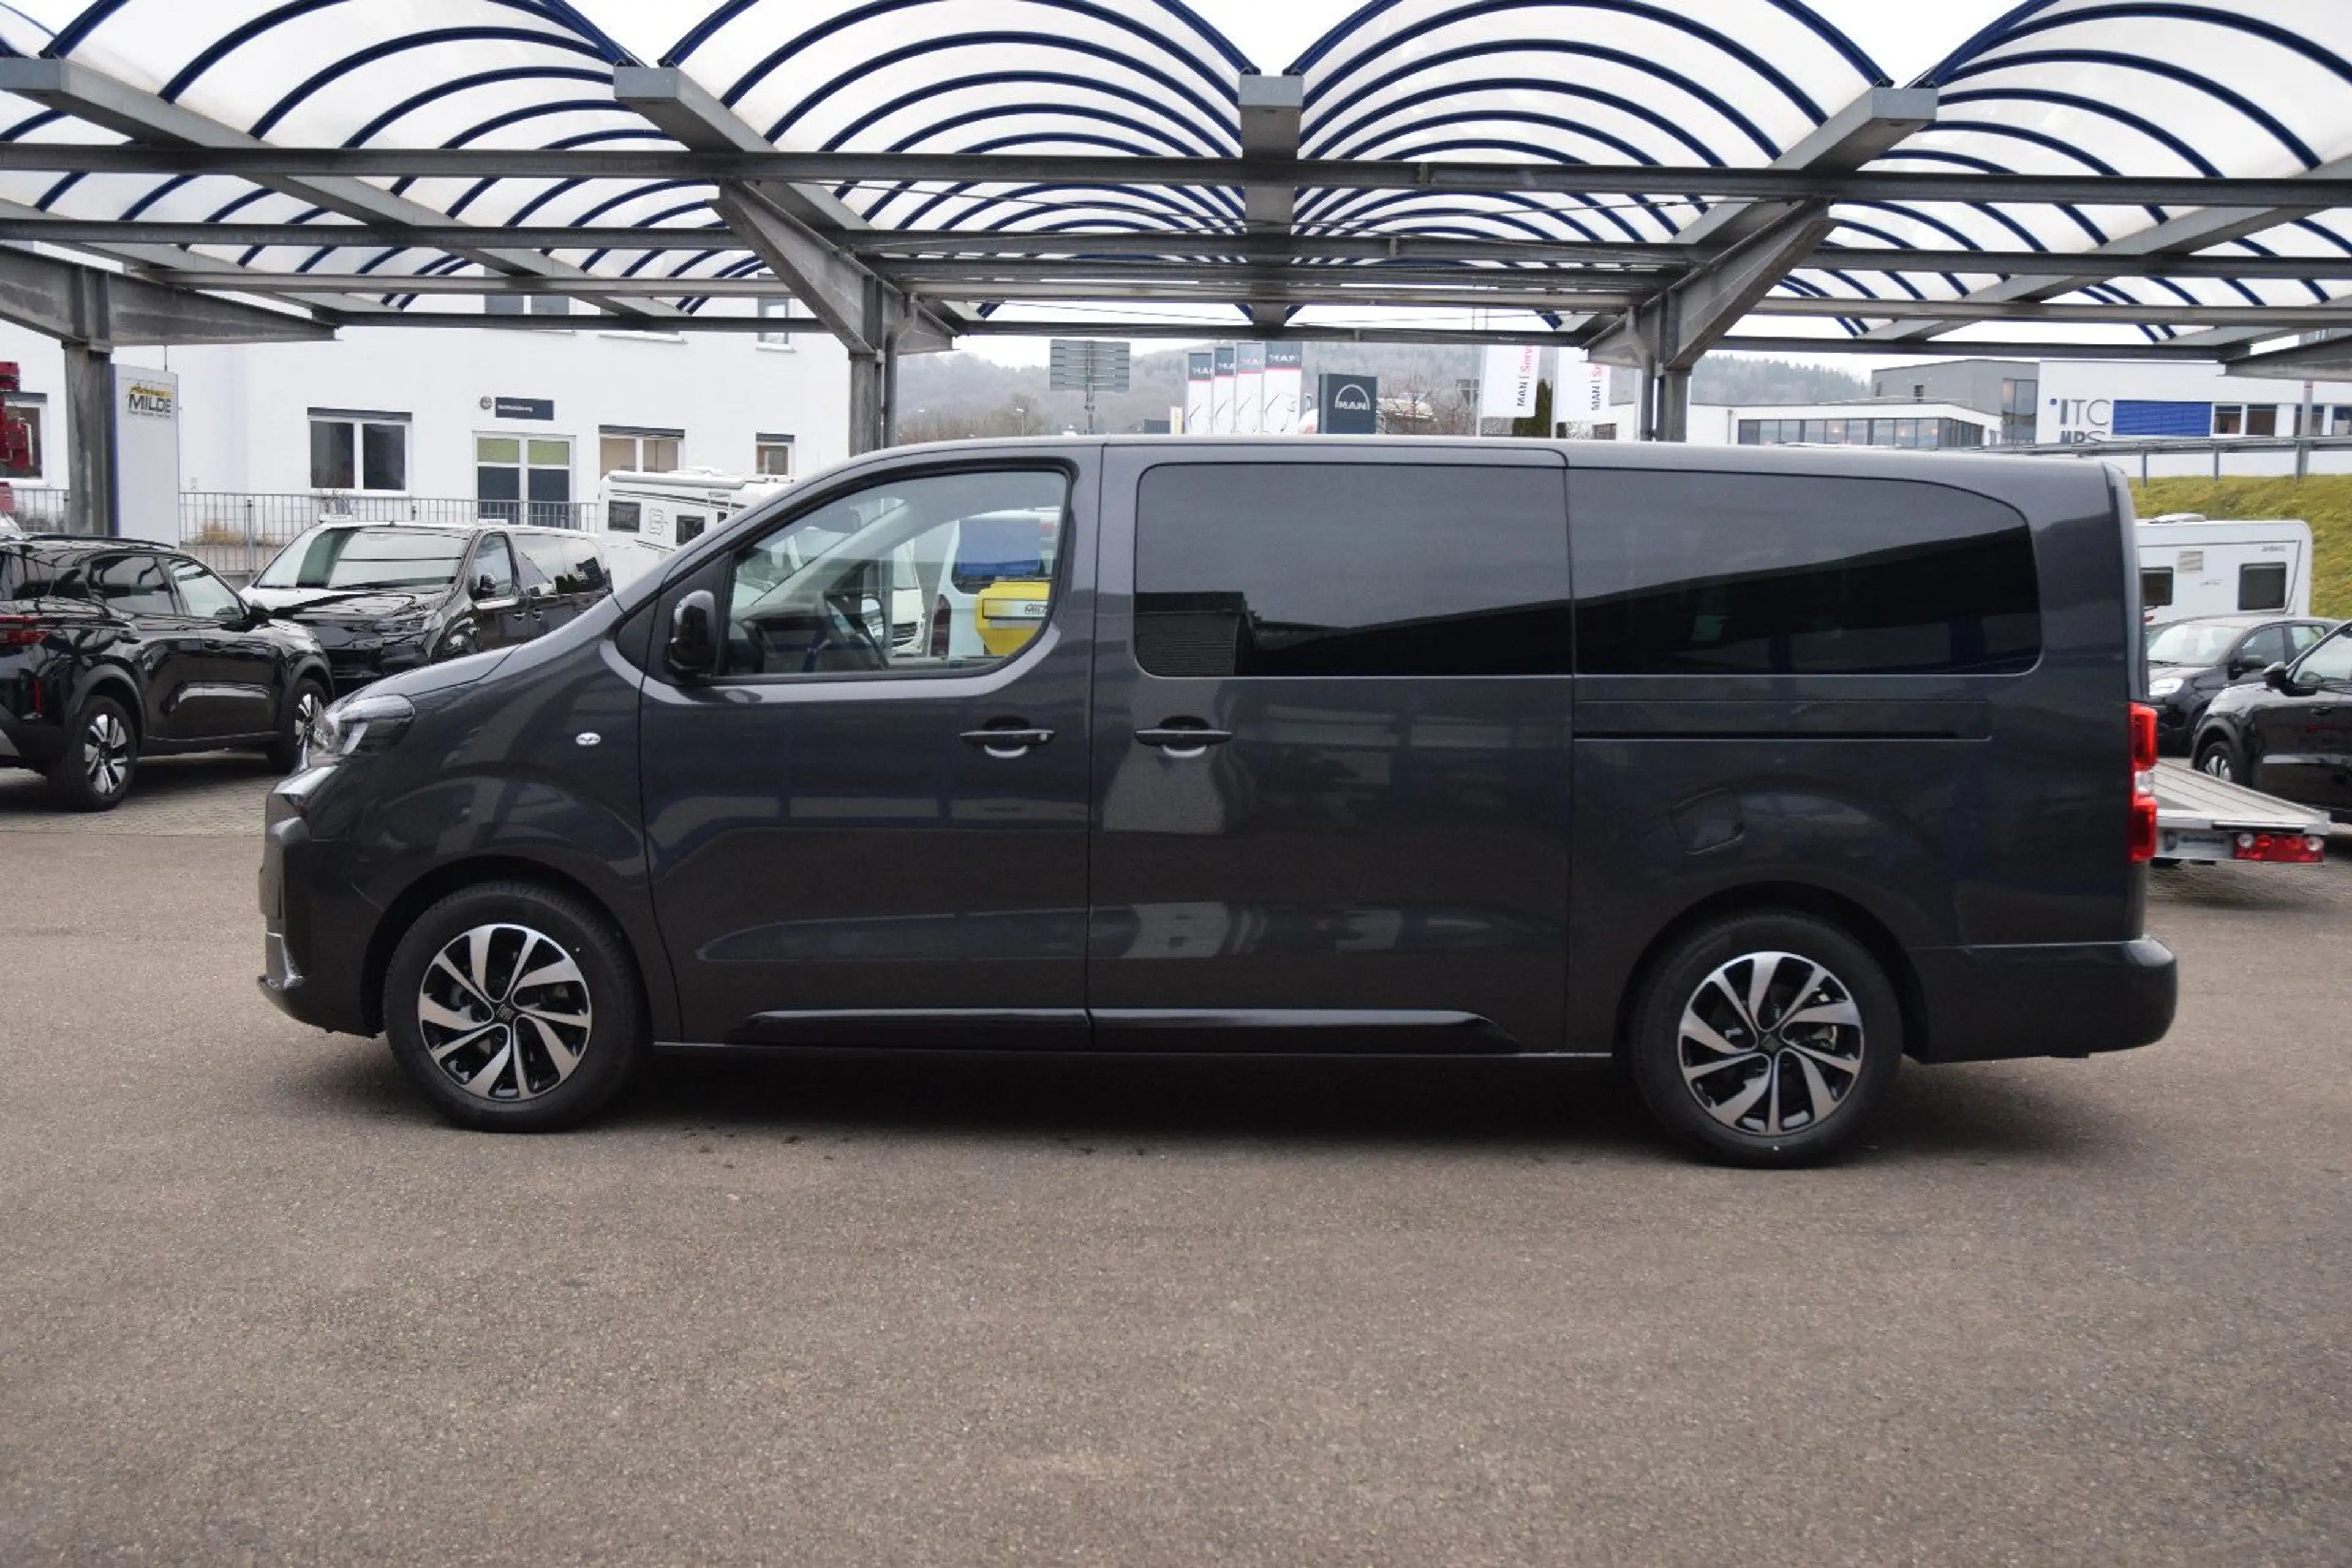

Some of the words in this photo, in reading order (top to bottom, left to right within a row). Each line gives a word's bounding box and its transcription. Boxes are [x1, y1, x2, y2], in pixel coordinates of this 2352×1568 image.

[128, 394, 172, 413] MILDE
[1336, 401, 1367, 410] MAN
[1517, 382, 1528, 407] MAN
[1591, 386, 1601, 411] MAN
[2060, 399, 2111, 426] ITC
